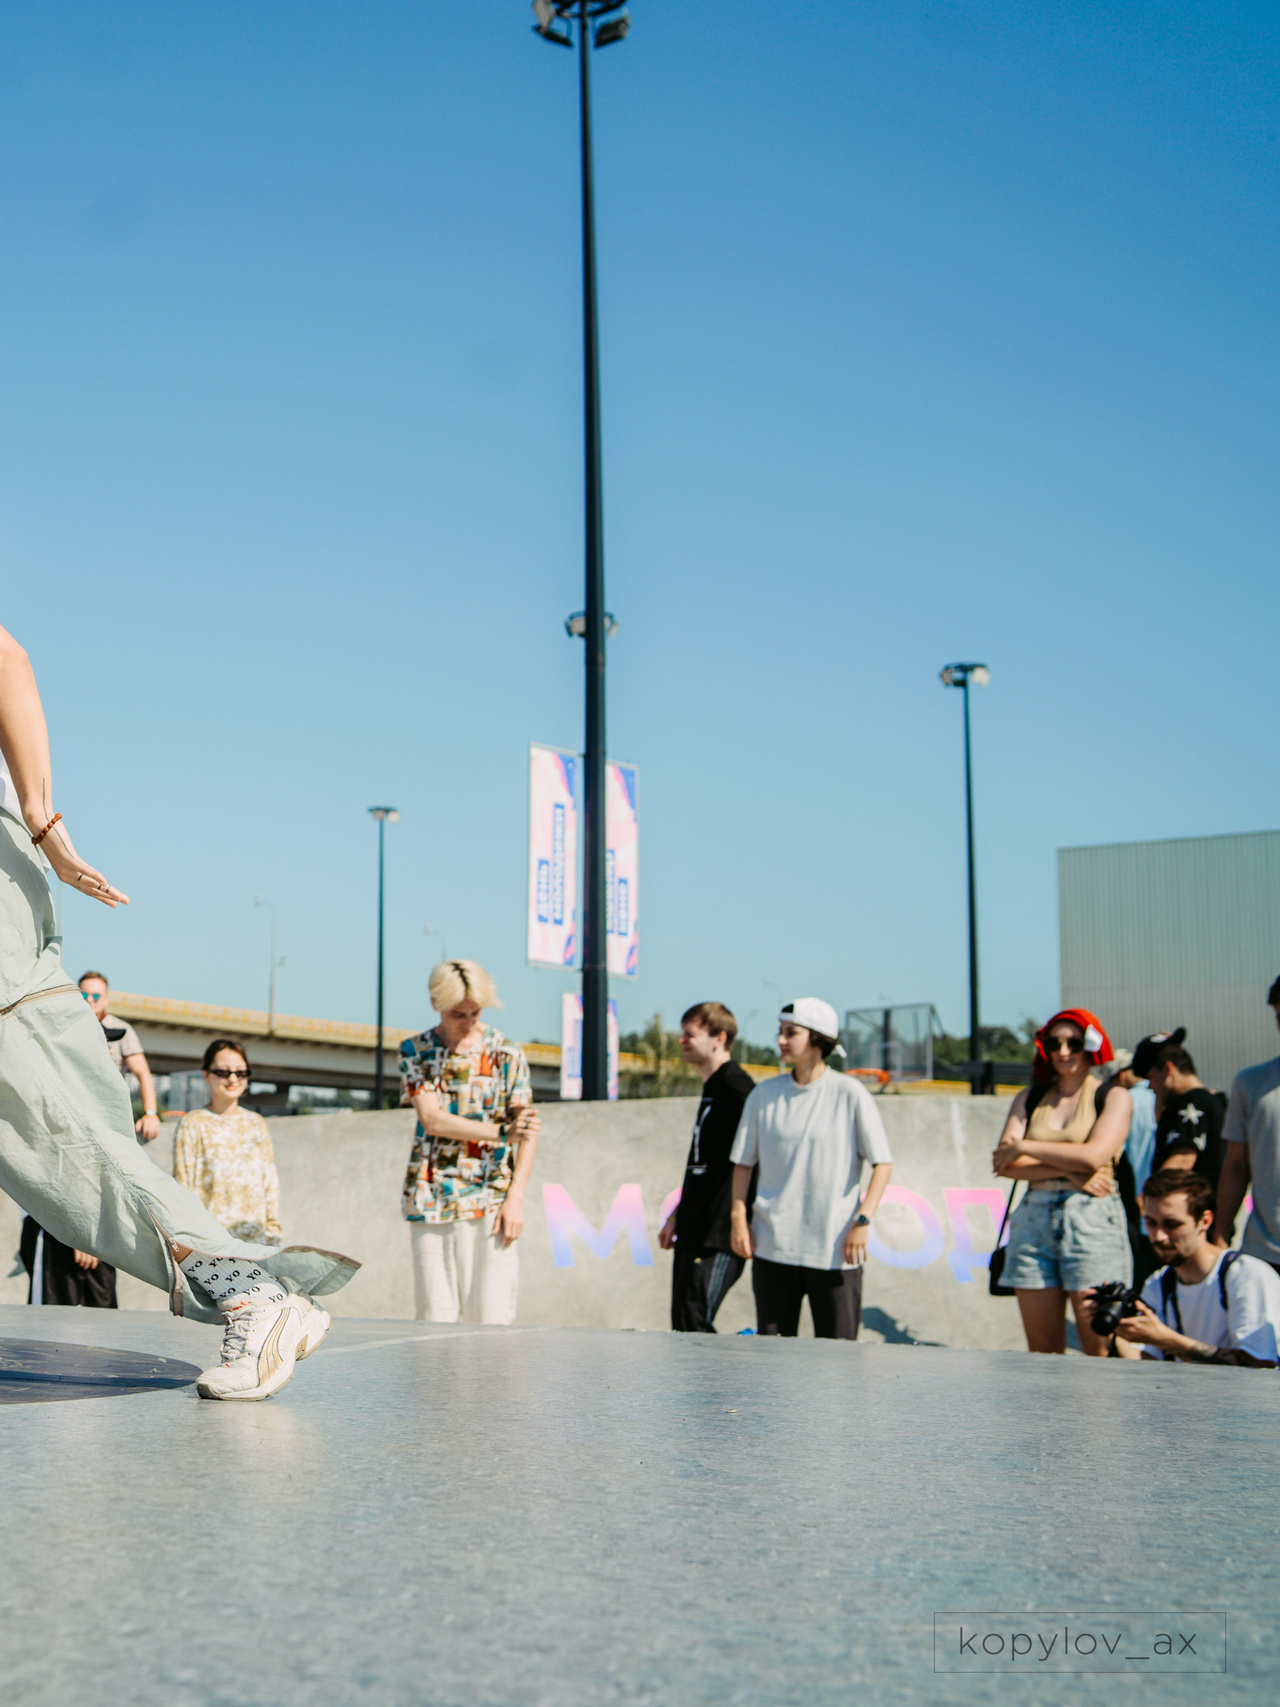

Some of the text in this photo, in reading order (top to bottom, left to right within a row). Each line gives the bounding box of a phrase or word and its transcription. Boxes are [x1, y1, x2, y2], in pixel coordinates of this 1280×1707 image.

[187, 1260, 203, 1273] YO
[204, 1273, 219, 1285] YO
[225, 1270, 240, 1282] YO
[245, 1269, 261, 1280] YO
[243, 1286, 260, 1296] YO
[268, 1293, 284, 1303] YO
